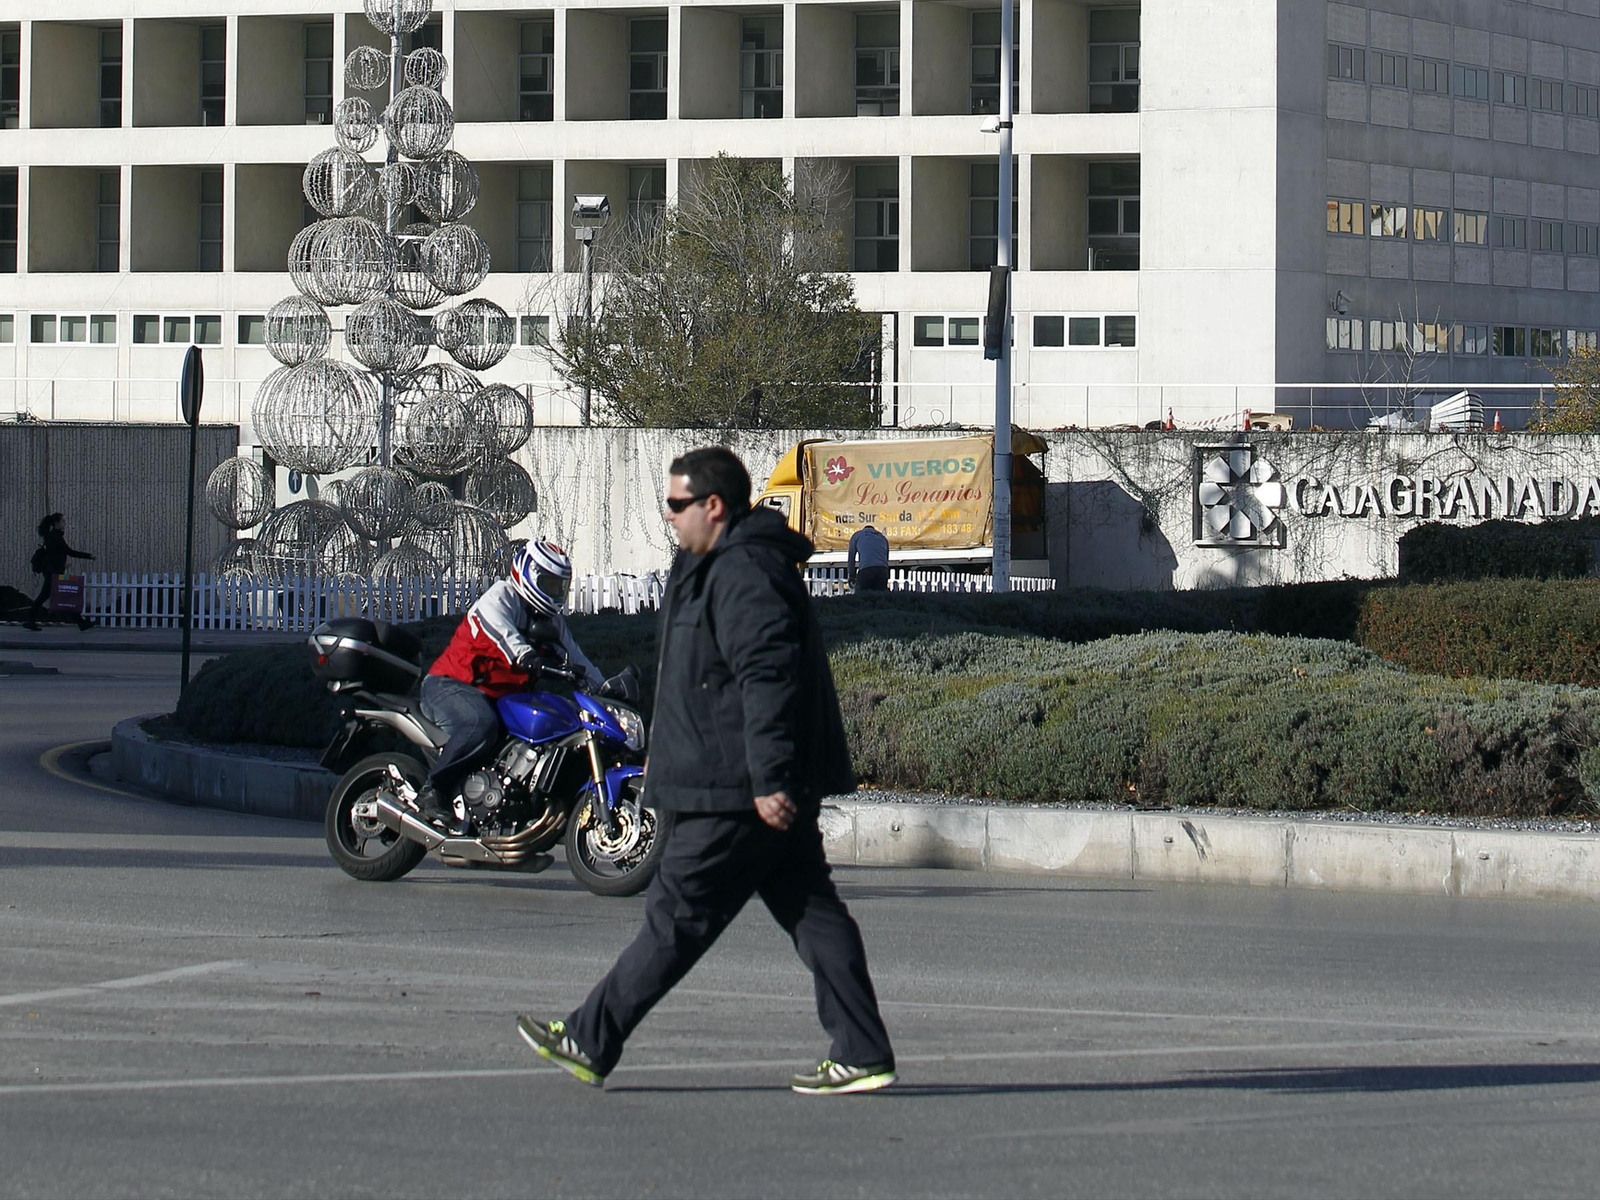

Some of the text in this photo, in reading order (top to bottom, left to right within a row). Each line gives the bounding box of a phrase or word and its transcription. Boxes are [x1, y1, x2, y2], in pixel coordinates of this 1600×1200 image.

[868, 457, 976, 479] VIVEROS
[853, 480, 983, 506] Los Geranios
[1285, 474, 1600, 518] CAJAGRANADA
[858, 511, 877, 524] Sur
